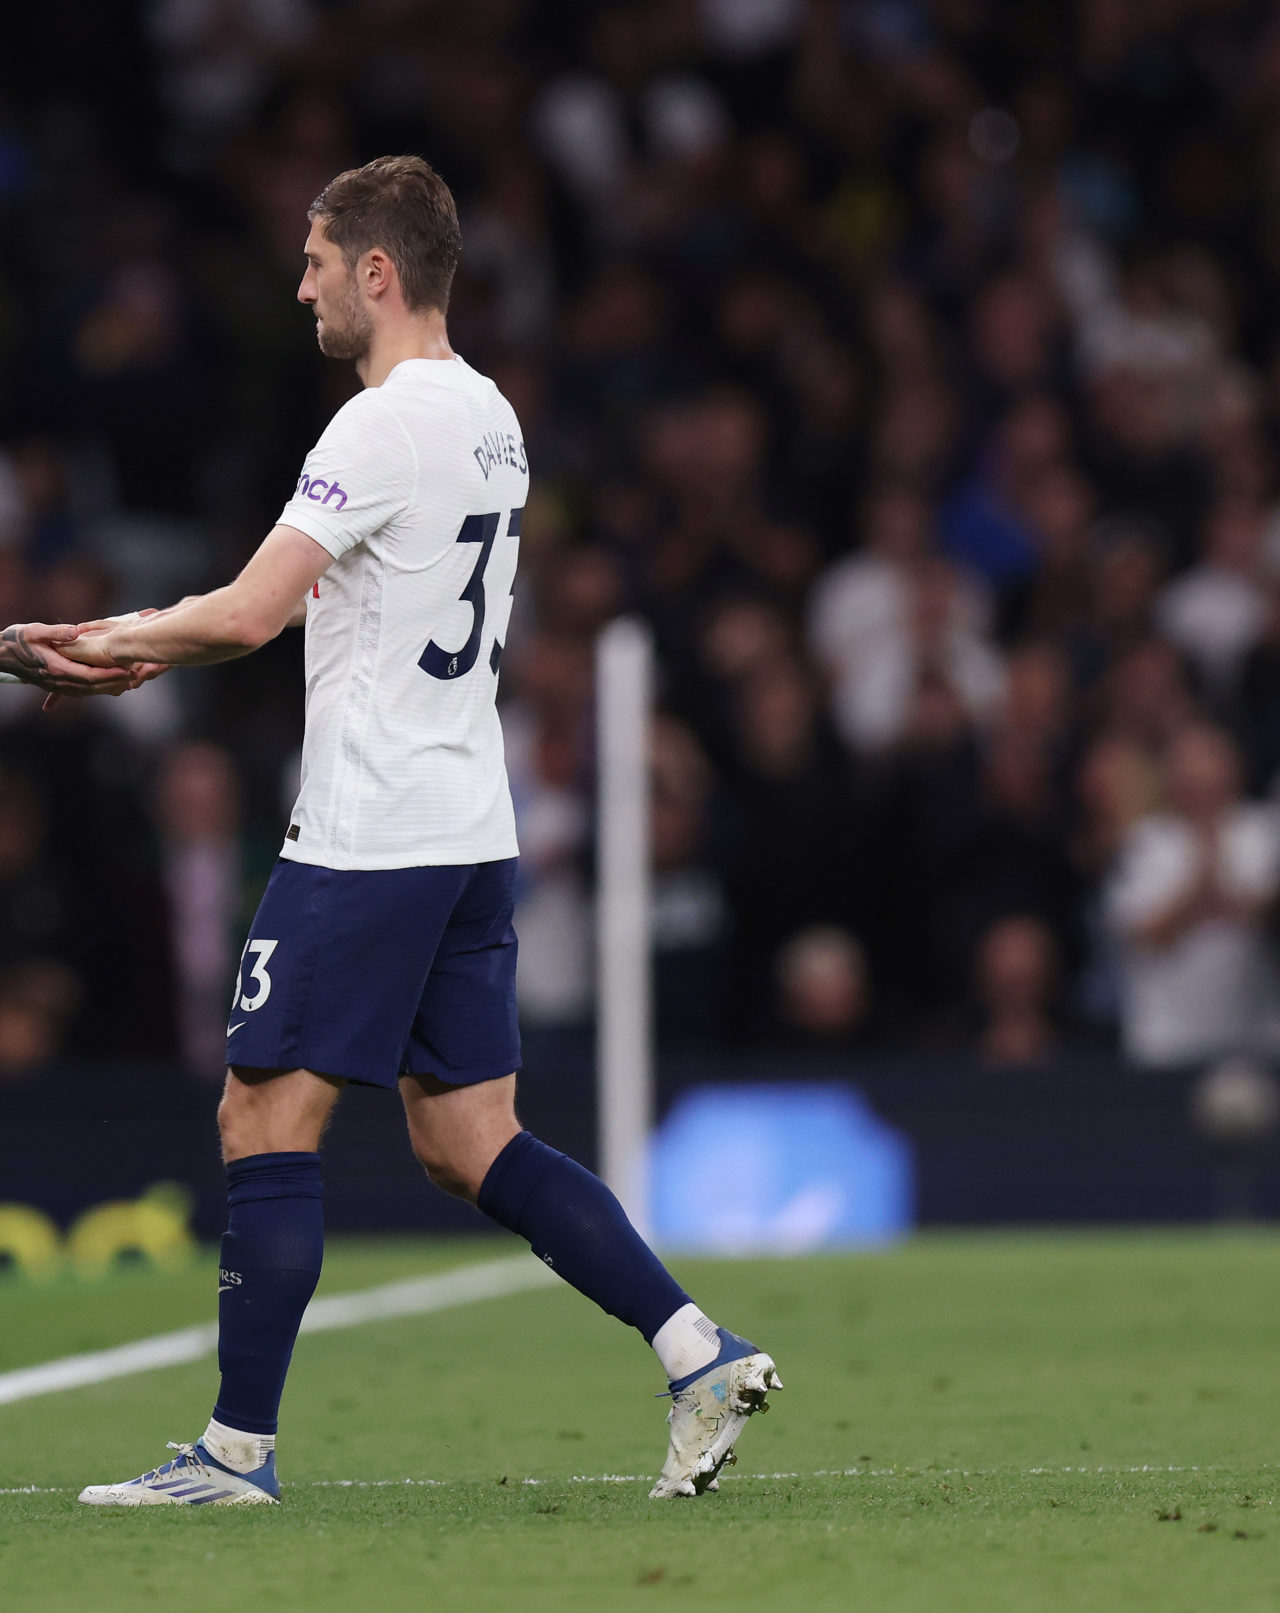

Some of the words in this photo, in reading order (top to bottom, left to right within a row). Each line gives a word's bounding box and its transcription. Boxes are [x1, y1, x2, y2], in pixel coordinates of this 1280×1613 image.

[473, 431, 527, 481] DAVIES
[232, 938, 278, 1012] 3
[219, 1268, 243, 1285] RS
